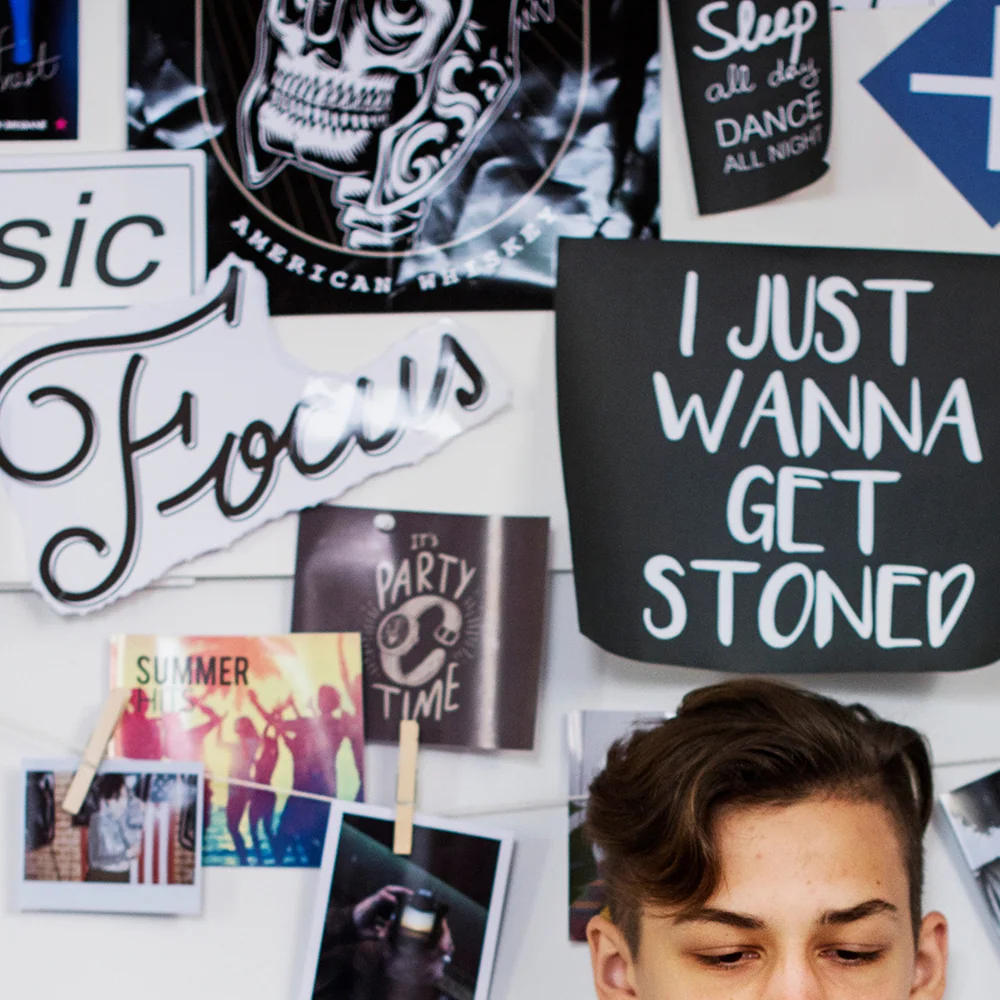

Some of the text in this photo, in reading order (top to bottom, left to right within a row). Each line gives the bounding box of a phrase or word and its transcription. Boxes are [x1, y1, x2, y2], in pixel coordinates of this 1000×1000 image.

[693, 0, 818, 65] Sleep
[705, 57, 822, 103] all day
[715, 90, 823, 148] DANCE
[722, 124, 824, 175] ALL NIGHT
[0, 191, 166, 290] sic
[230, 206, 558, 294] AMERICAN WHISKEY
[679, 270, 935, 366] I JUST
[0, 264, 489, 604] Focus
[653, 368, 983, 463] WANNA
[726, 464, 902, 556] GET
[376, 551, 478, 611] PARTY
[643, 554, 975, 649] STONED
[136, 655, 249, 686] SUMMER
[372, 662, 461, 722] TIME
